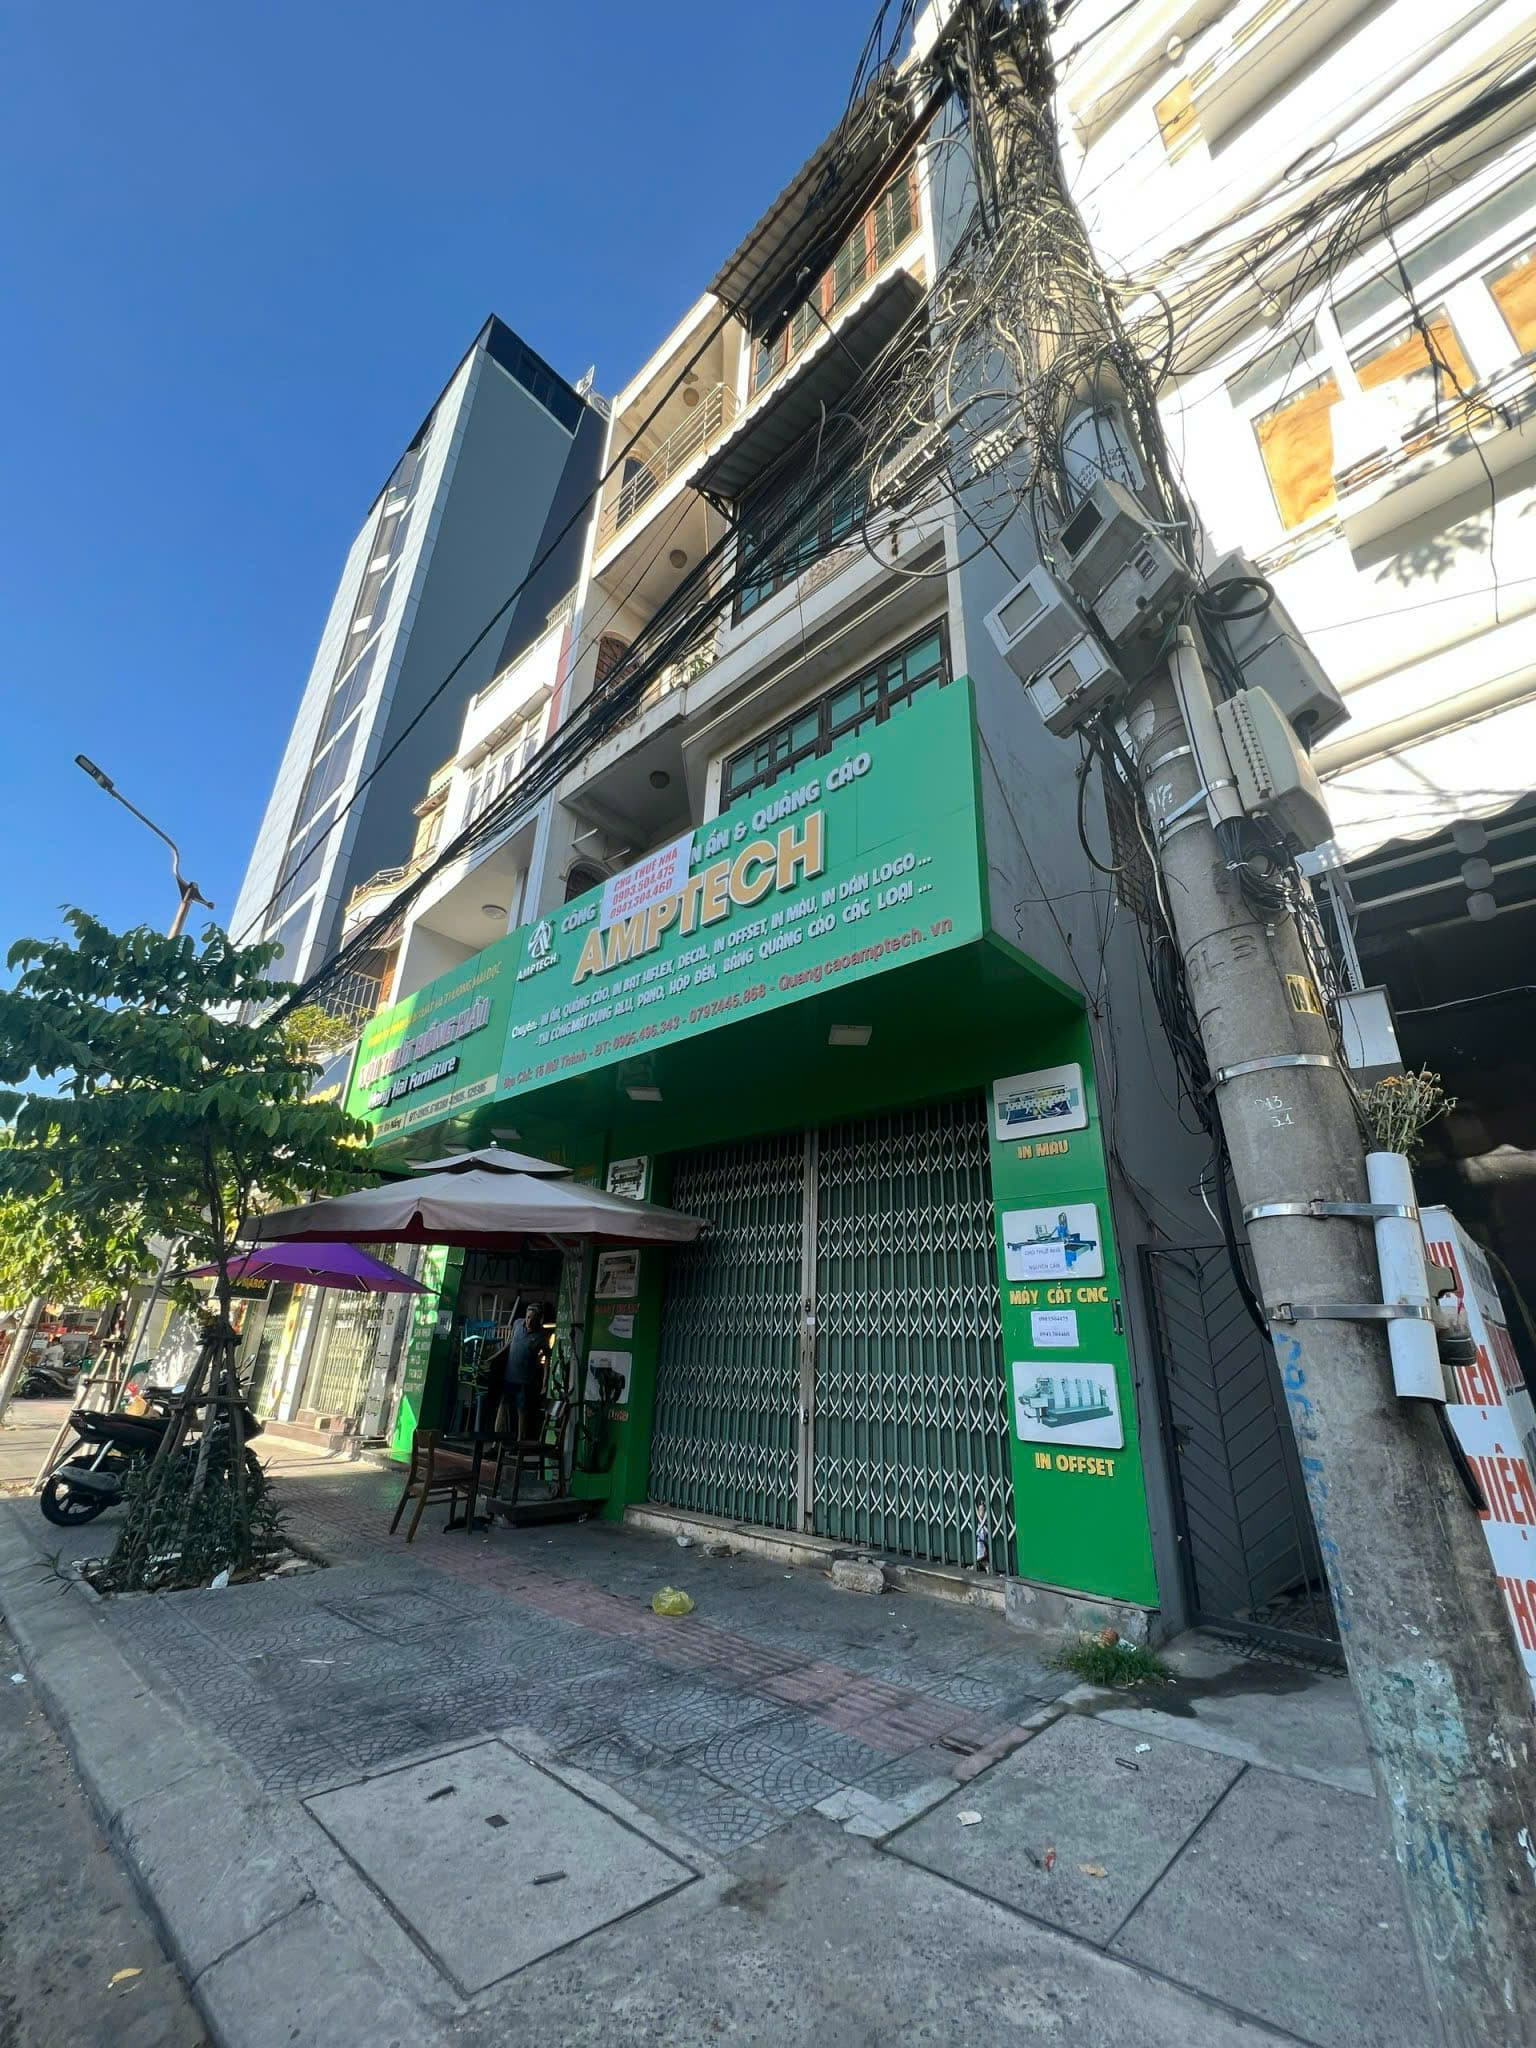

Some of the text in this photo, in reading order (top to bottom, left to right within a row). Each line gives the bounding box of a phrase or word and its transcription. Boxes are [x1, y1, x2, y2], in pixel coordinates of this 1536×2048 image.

[561, 902, 598, 934] CÔNG
[705, 827, 730, 858] ẤN
[733, 820, 749, 842] &
[752, 779, 821, 833] QUẢNG
[826, 752, 872, 791] CÁO
[572, 809, 827, 986] AMPTECH
[612, 981, 623, 997] IN
[713, 936, 725, 955] IN
[727, 918, 768, 948] OFFSET,
[771, 911, 784, 930] IN
[821, 887, 836, 908] IN
[839, 872, 869, 901] DÁN
[872, 853, 916, 886] LOGO
[669, 974, 692, 996] HỘP
[759, 927, 802, 960] QUẢNG
[807, 913, 837, 939] CÁO
[842, 898, 871, 924] CÁC
[878, 880, 913, 911] LOẠI
[516, 952, 558, 981] AMPTECH
[408, 1055, 458, 1091] Furniture
[1017, 1144, 1033, 1160] IN
[1009, 1286, 1038, 1305] MÁY
[1076, 1286, 1109, 1304] CNC
[1034, 1452, 1115, 1477] IN OFFSET
